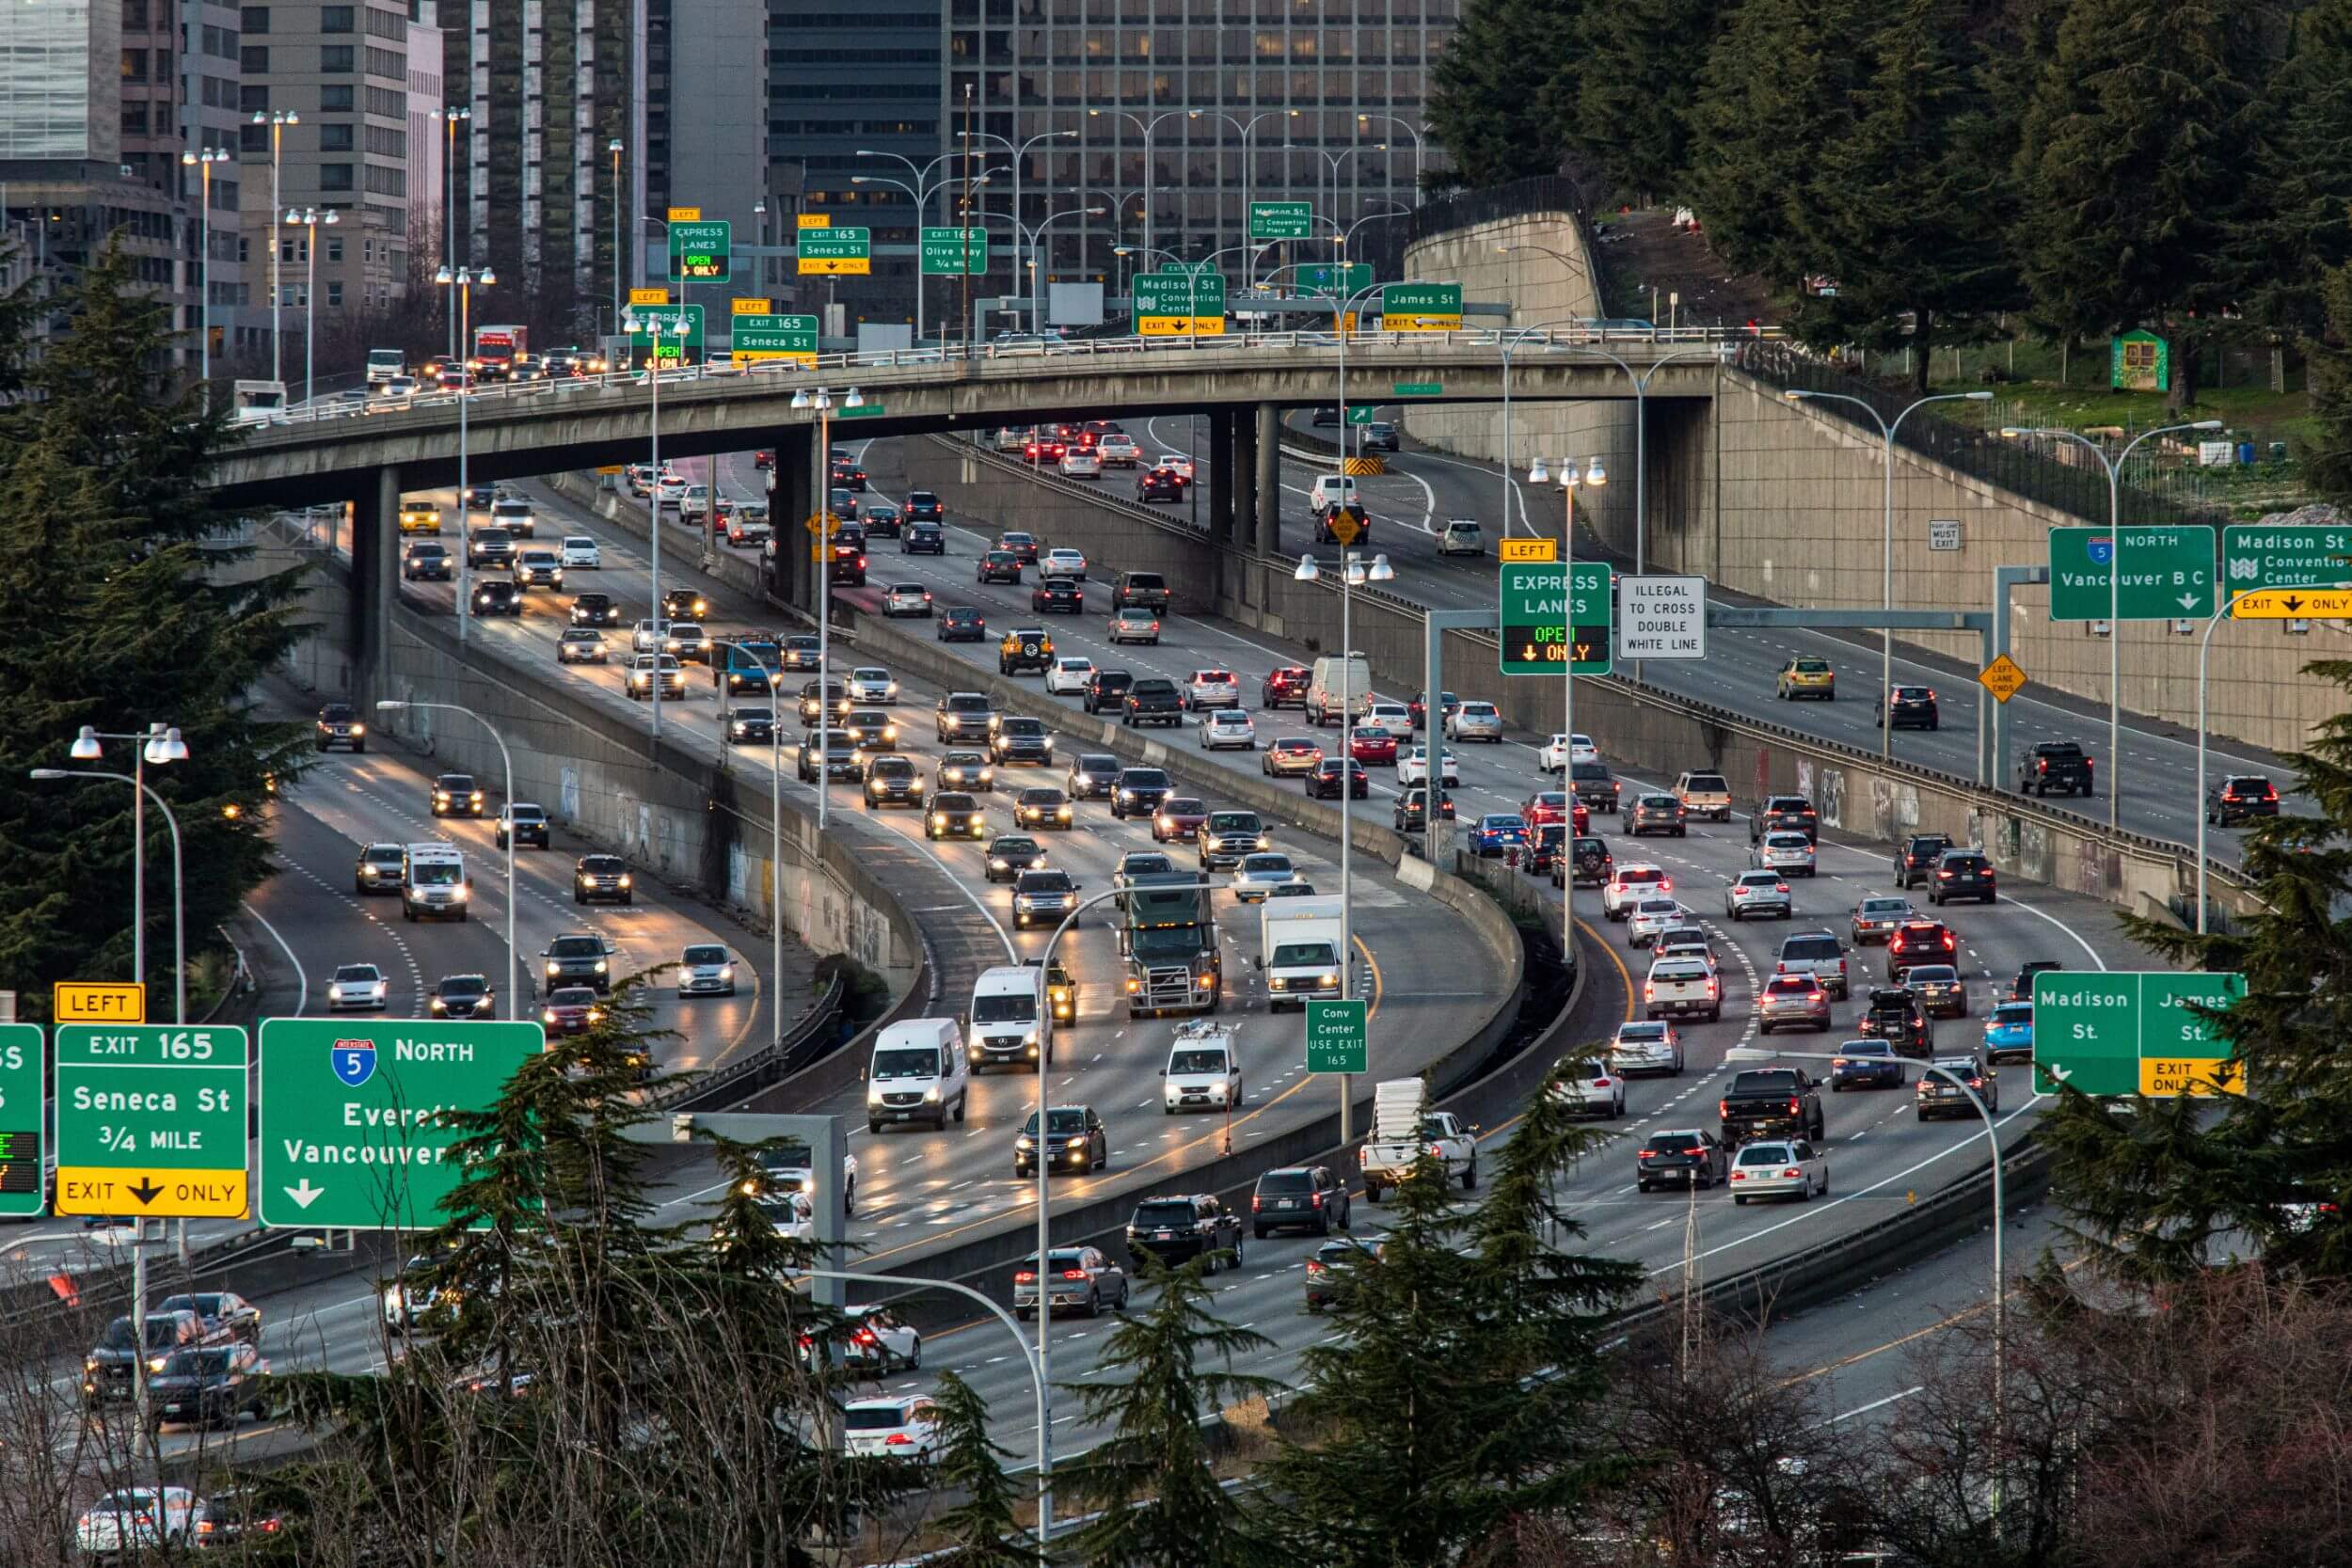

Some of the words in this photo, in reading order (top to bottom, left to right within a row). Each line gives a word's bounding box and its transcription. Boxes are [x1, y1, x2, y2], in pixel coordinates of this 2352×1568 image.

[675, 228, 723, 237] EXPRESS
[835, 230, 855, 239] 165
[954, 230, 976, 239] 166
[806, 245, 844, 254] Seneca
[850, 245, 862, 254] St
[926, 247, 954, 256] Olive
[687, 256, 710, 265] OPEN
[693, 265, 719, 276] ONLY
[1201, 280, 1216, 290] St
[1160, 293, 1220, 302] Convention
[1391, 294, 1434, 304] James
[1440, 294, 1454, 304] St
[1160, 304, 1197, 313] Cente
[639, 313, 696, 323] EPRES
[778, 318, 801, 328] 165
[743, 337, 787, 346] Seneca
[793, 338, 808, 346] St
[2126, 536, 2178, 546] NORTH
[2238, 535, 2314, 548] Madison
[2326, 534, 2345, 548] St
[1511, 546, 1545, 556] LEFT
[2098, 547, 2106, 558] 5
[2265, 556, 2349, 567] Conventio
[1513, 576, 1598, 590] EXPRESS
[2265, 572, 2317, 583] Center
[1636, 585, 1689, 596] ILLEGAL
[1629, 603, 1645, 614] TO
[1654, 603, 1695, 614] CROSS
[2243, 598, 2272, 609] EXIT
[2312, 599, 2349, 609] ONLY
[1638, 621, 1687, 632] DOUBLE
[1628, 639, 1663, 650] WHITE
[1671, 639, 1698, 650] LINE
[72, 995, 127, 1012] LEFT
[2041, 991, 2128, 1006] Madison
[1323, 1008, 1350, 1019] Conv
[1317, 1024, 1355, 1034] Center
[2073, 1023, 2098, 1039] St.
[2181, 1025, 2207, 1041] St.
[89, 1037, 138, 1054] EXIT
[158, 1033, 213, 1060] 165
[1309, 1039, 1332, 1050] USE
[1339, 1038, 1363, 1050] EXIT
[395, 1038, 473, 1062] NORTH
[347, 1053, 361, 1075] 5
[1327, 1055, 1347, 1065] 165
[2156, 1063, 2192, 1075] EXIT
[73, 1086, 177, 1111] Seneca
[198, 1087, 230, 1112] St
[99, 1126, 136, 1152] 3/4
[151, 1132, 202, 1149] MILE
[284, 1139, 447, 1164] Vancouver
[67, 1181, 115, 1199] EXIT
[176, 1184, 235, 1201] ONLY
